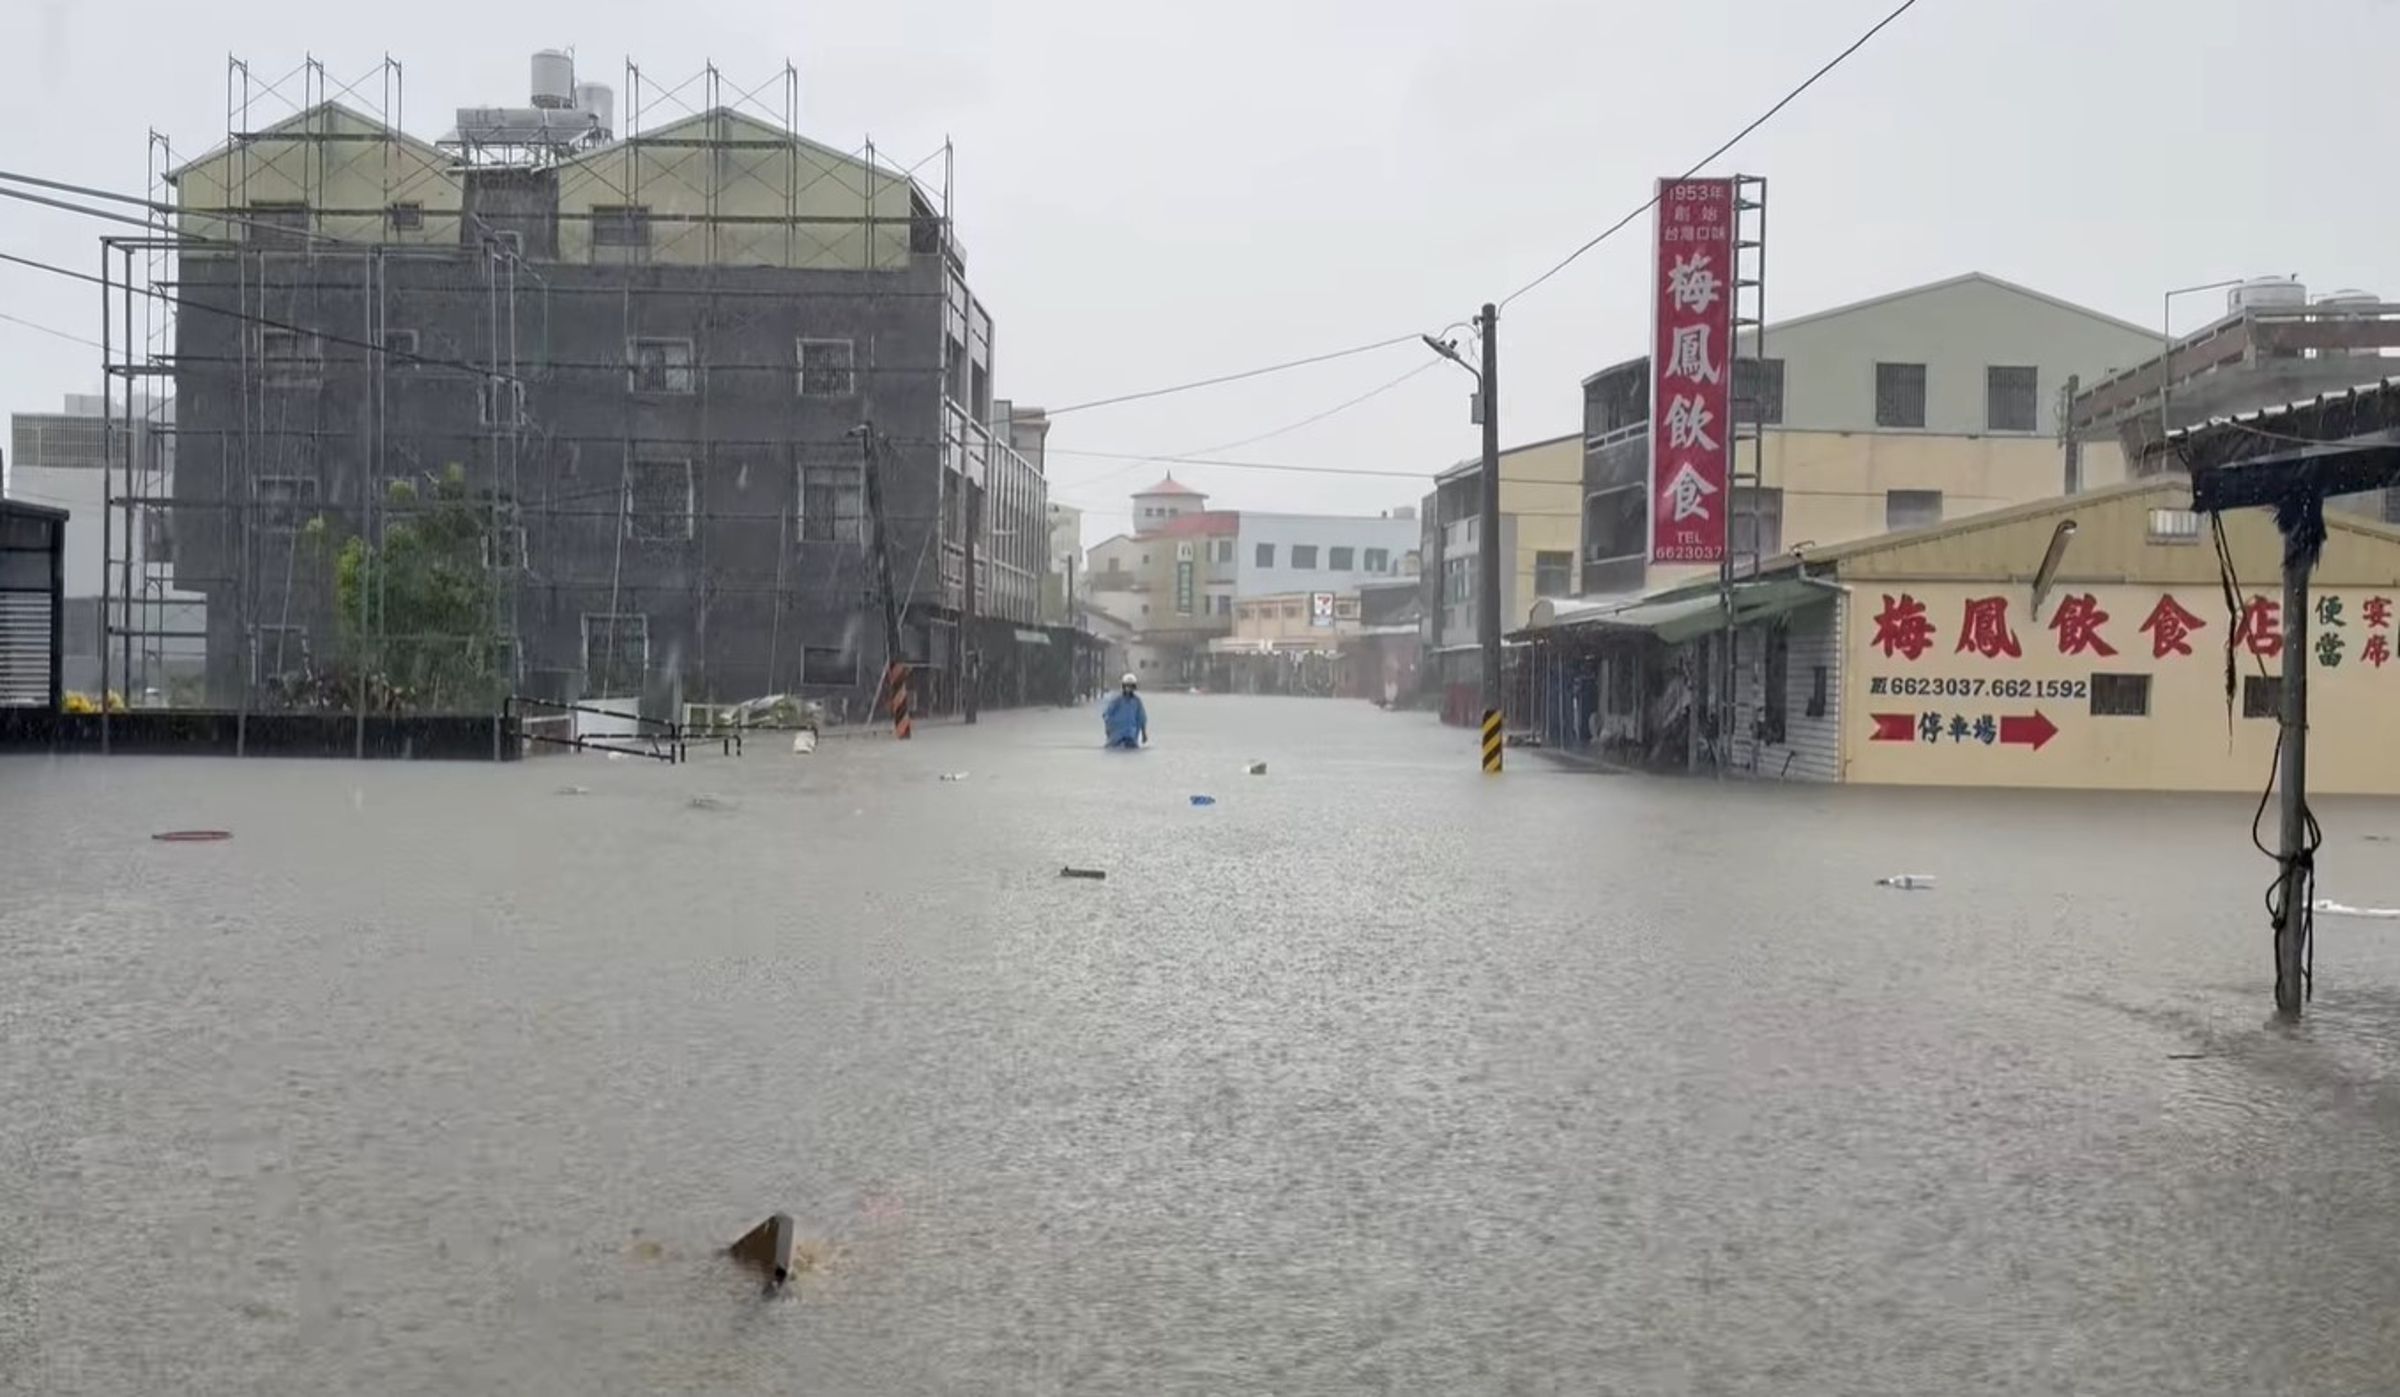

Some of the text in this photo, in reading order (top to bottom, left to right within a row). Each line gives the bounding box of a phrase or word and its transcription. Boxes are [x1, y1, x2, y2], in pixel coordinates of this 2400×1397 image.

[1669, 184, 1723, 201] 1953年
[1664, 225, 1725, 241] 台灣口味
[1663, 251, 1723, 521] 梅鳳飲食
[1677, 531, 1703, 545] TEL
[1655, 546, 1723, 560] 6623037
[1869, 593, 2284, 660] 梅鳳飲食店
[2314, 595, 2347, 668] 便當
[2360, 595, 2393, 669] 宴席
[1890, 677, 2087, 699] 6623037.6621592
[1917, 711, 1998, 745] 停車場
